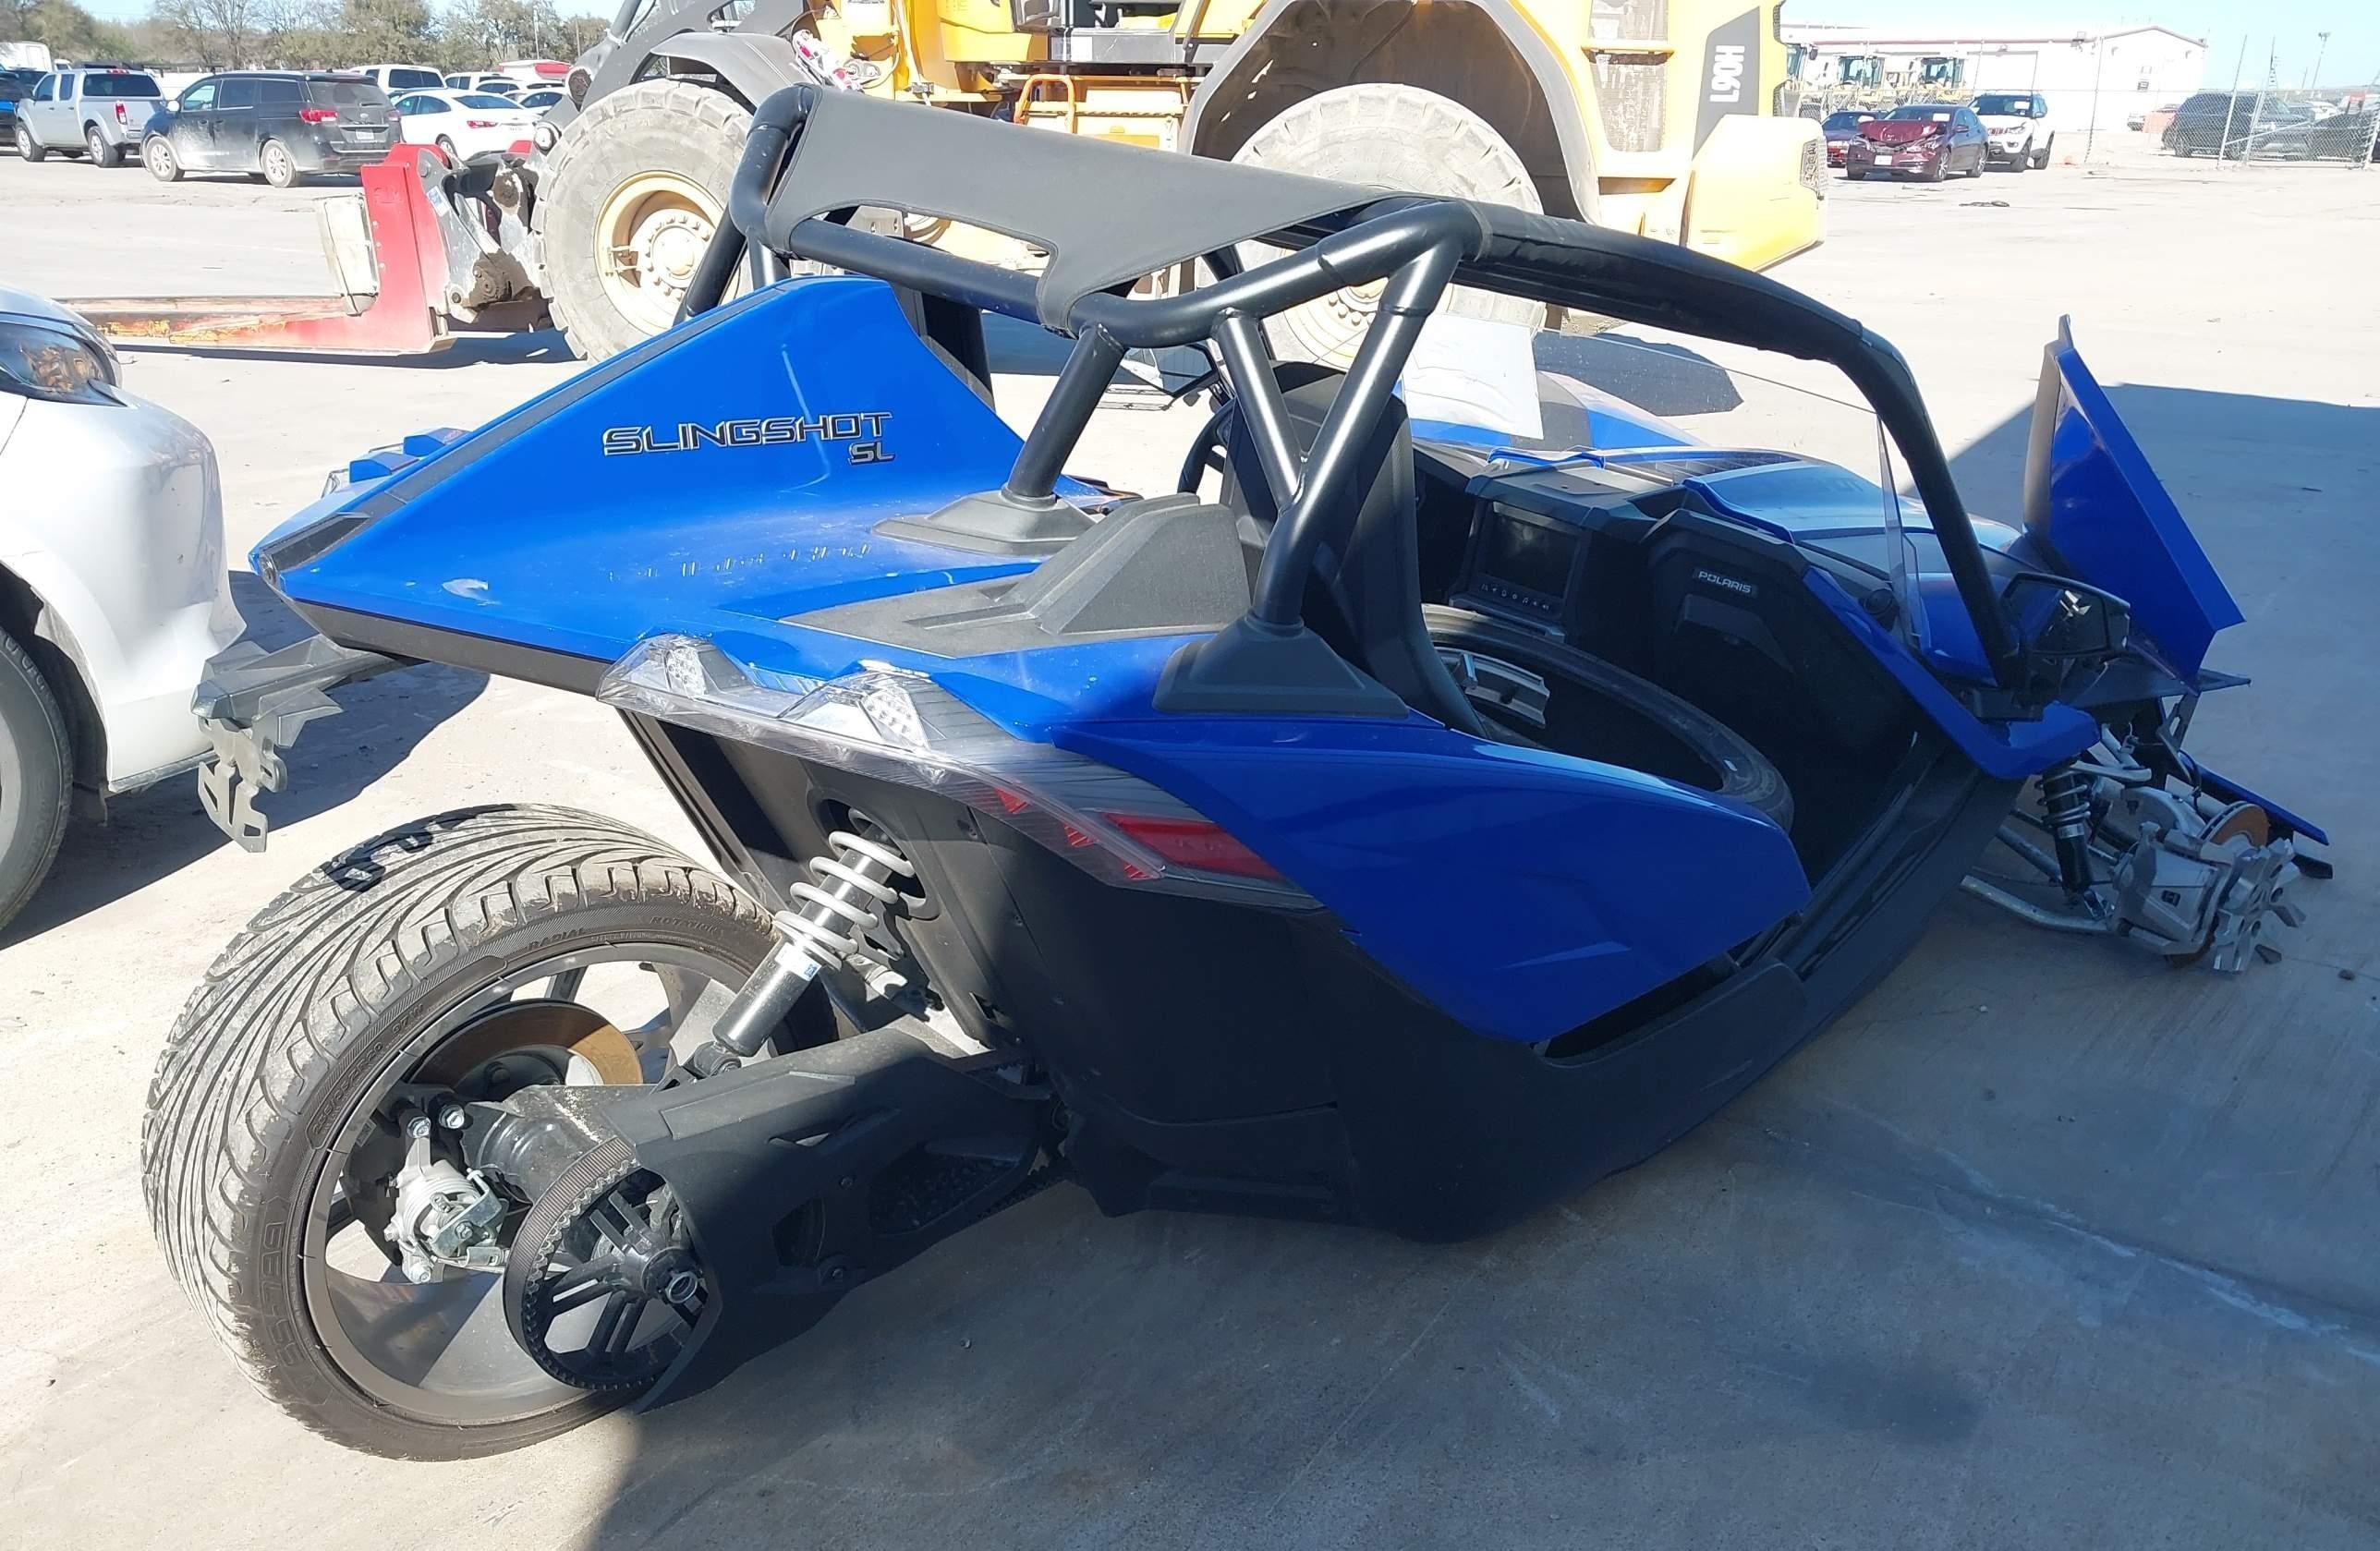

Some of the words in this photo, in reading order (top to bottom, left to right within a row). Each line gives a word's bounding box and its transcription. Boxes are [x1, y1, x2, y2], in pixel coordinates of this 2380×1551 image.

[1709, 45, 1745, 103] L90H
[602, 411, 893, 456] SLINGSHOT
[847, 441, 896, 465] SL
[1698, 571, 1752, 593] POLARIS
